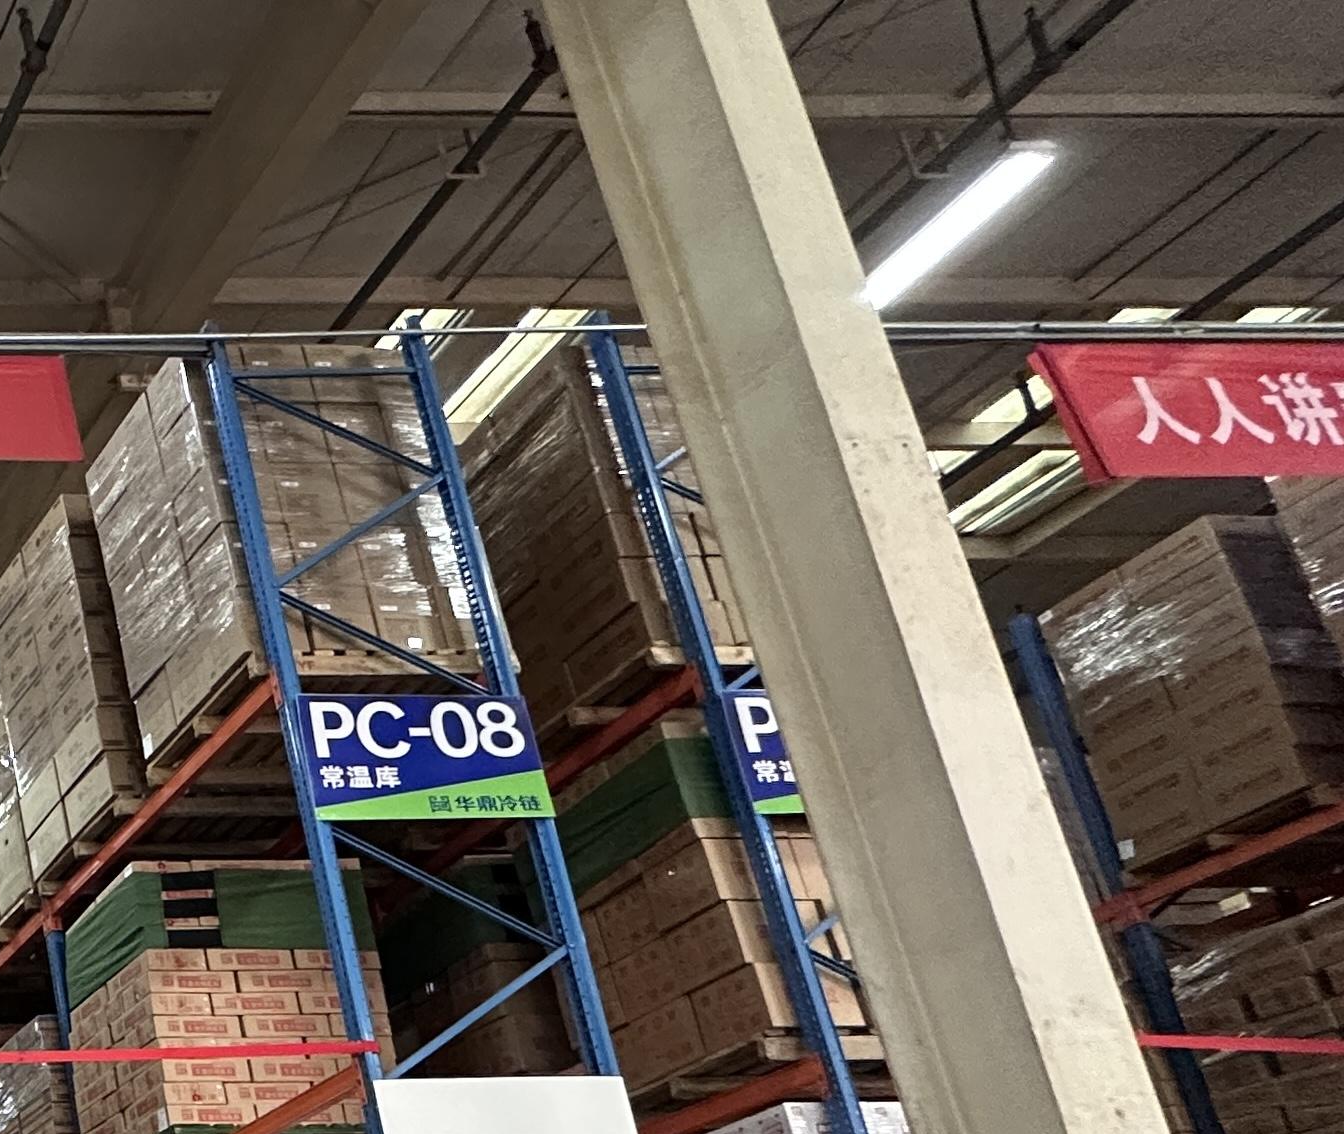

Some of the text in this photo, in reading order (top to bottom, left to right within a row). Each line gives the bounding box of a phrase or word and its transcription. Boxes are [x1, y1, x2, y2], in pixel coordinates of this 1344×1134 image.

[1132, 372, 1344, 445] 人人讲
[308, 701, 526, 759] PC-08
[318, 764, 402, 790] 常温库
[454, 795, 543, 813] 华鼎冷链
